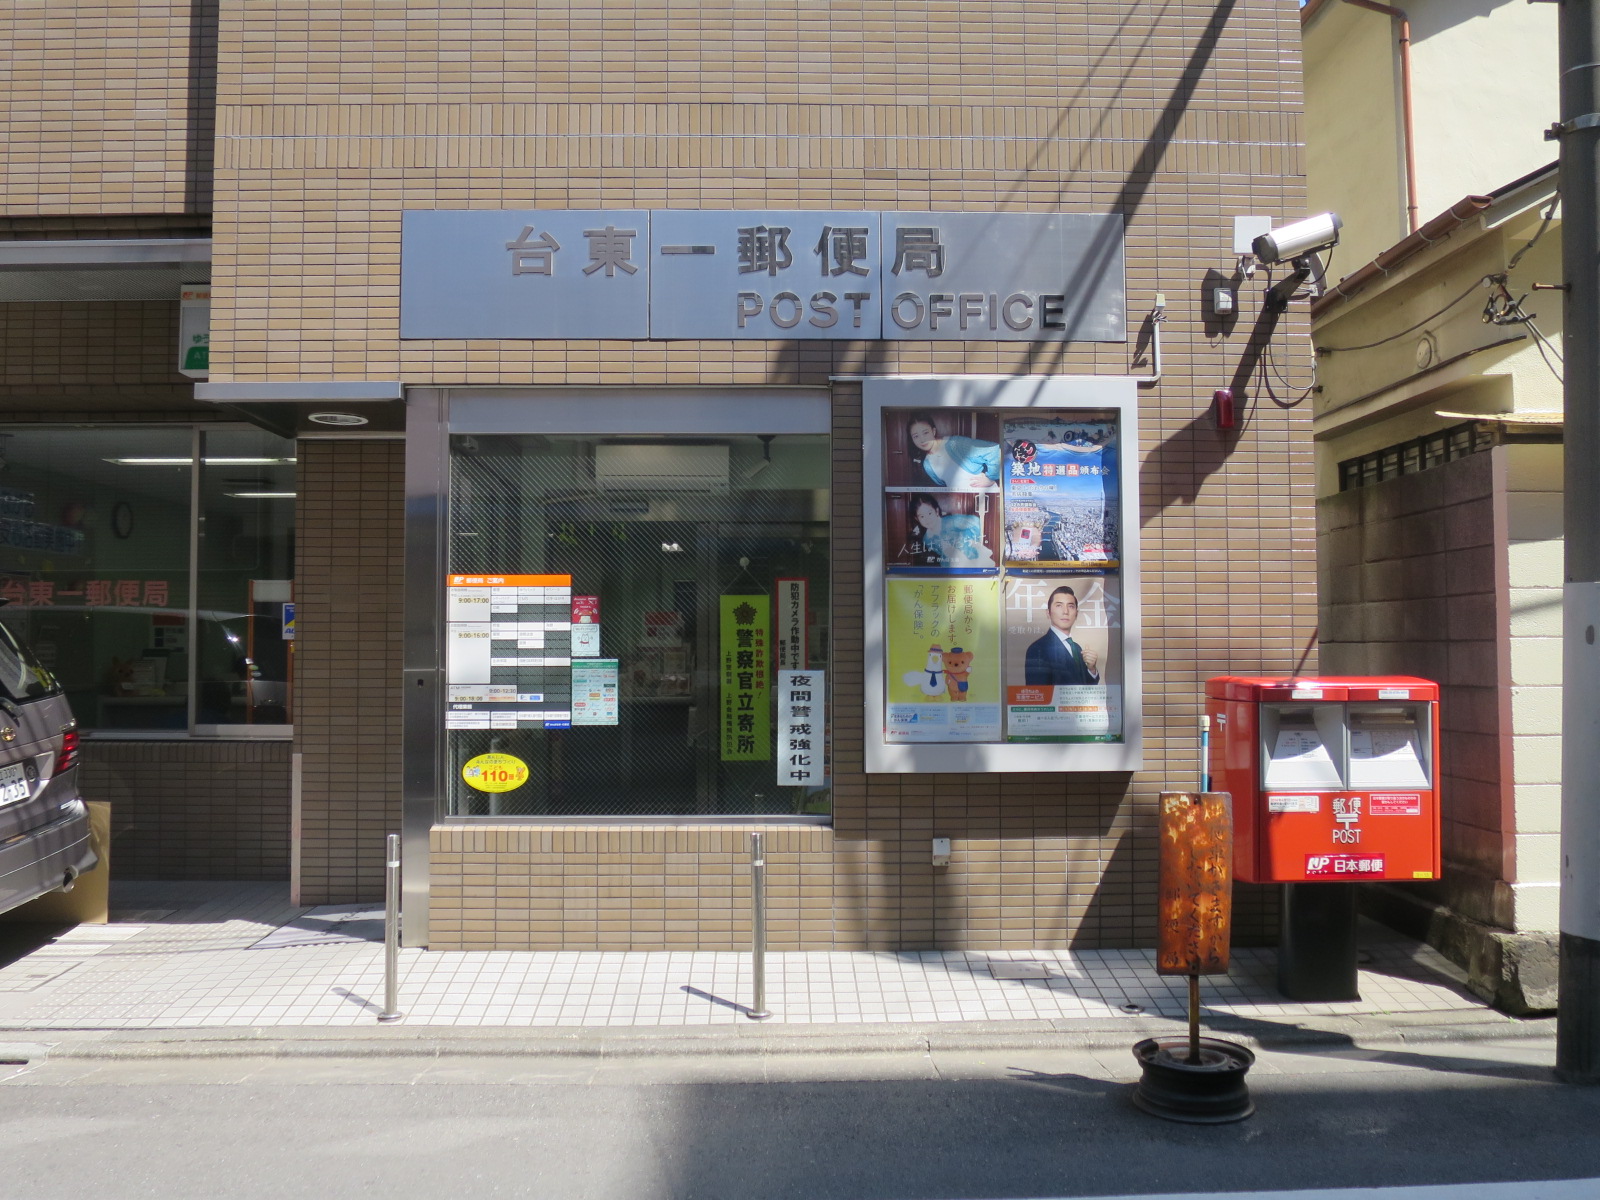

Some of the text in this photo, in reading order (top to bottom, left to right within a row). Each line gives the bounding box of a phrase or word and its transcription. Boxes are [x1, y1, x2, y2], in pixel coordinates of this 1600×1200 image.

[506, 223, 946, 277] 台東一郵便局
[736, 291, 1067, 330] POST OFFICE
[1, 580, 169, 607] 台東一郵便局
[930, 584, 940, 637] アフラックの
[946, 584, 957, 646] お届けします。
[963, 584, 974, 635] 郵便局から
[790, 582, 800, 670] 防犯カメラ作動中です
[736, 628, 755, 754] 警察官立寄所
[789, 674, 812, 781] 夜間警戒強化中
[1332, 797, 1361, 815] 郵便
[1332, 829, 1361, 843] POST
[1334, 859, 1383, 872] 日本郵便
